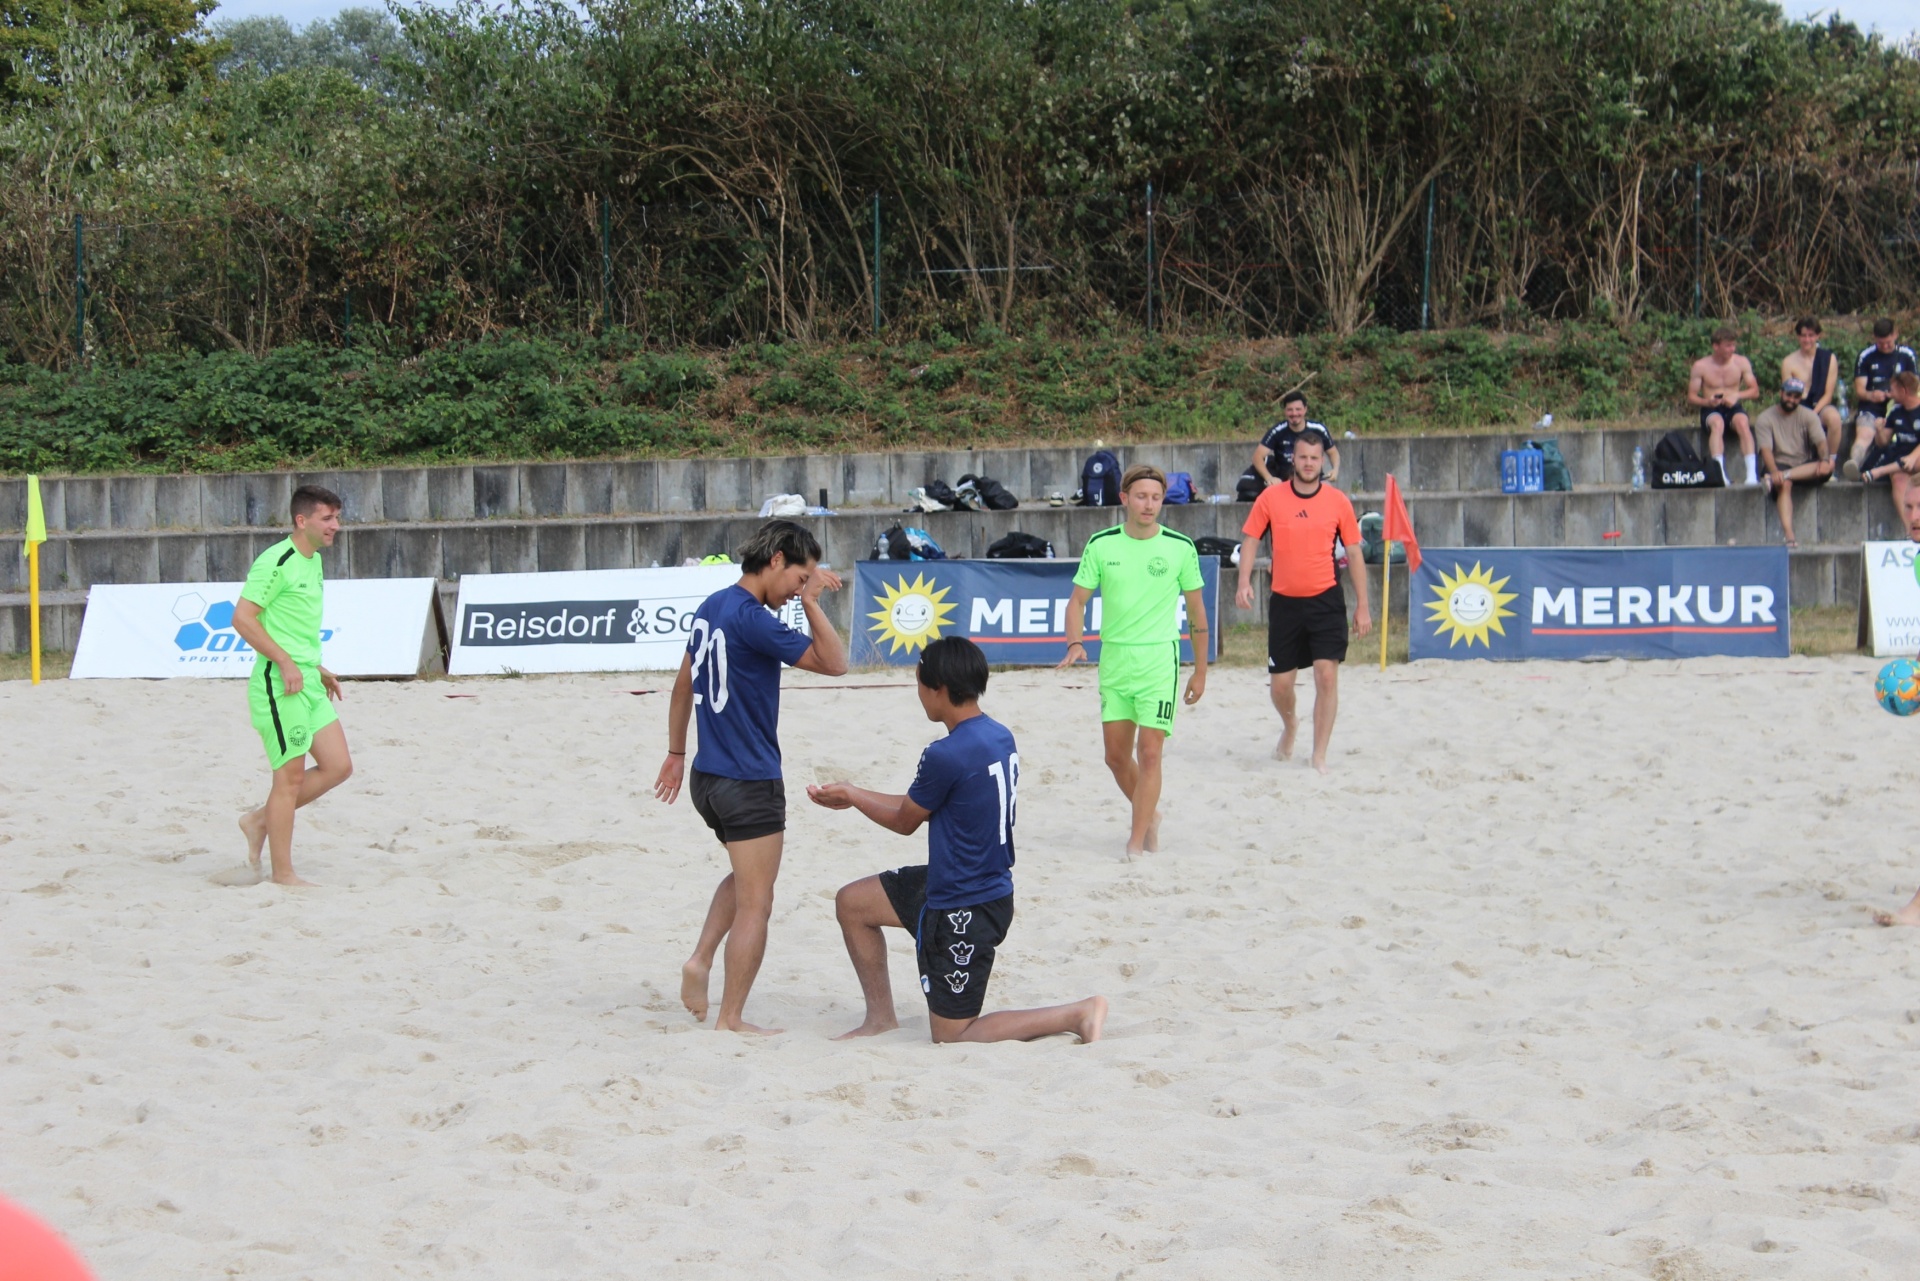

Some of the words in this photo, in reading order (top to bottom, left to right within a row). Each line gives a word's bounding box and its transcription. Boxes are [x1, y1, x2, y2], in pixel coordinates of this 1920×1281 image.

[1531, 585, 1777, 625] MERKUR
[468, 608, 616, 640] Reisdorf
[690, 618, 729, 713] 20
[1156, 700, 1172, 719] 10
